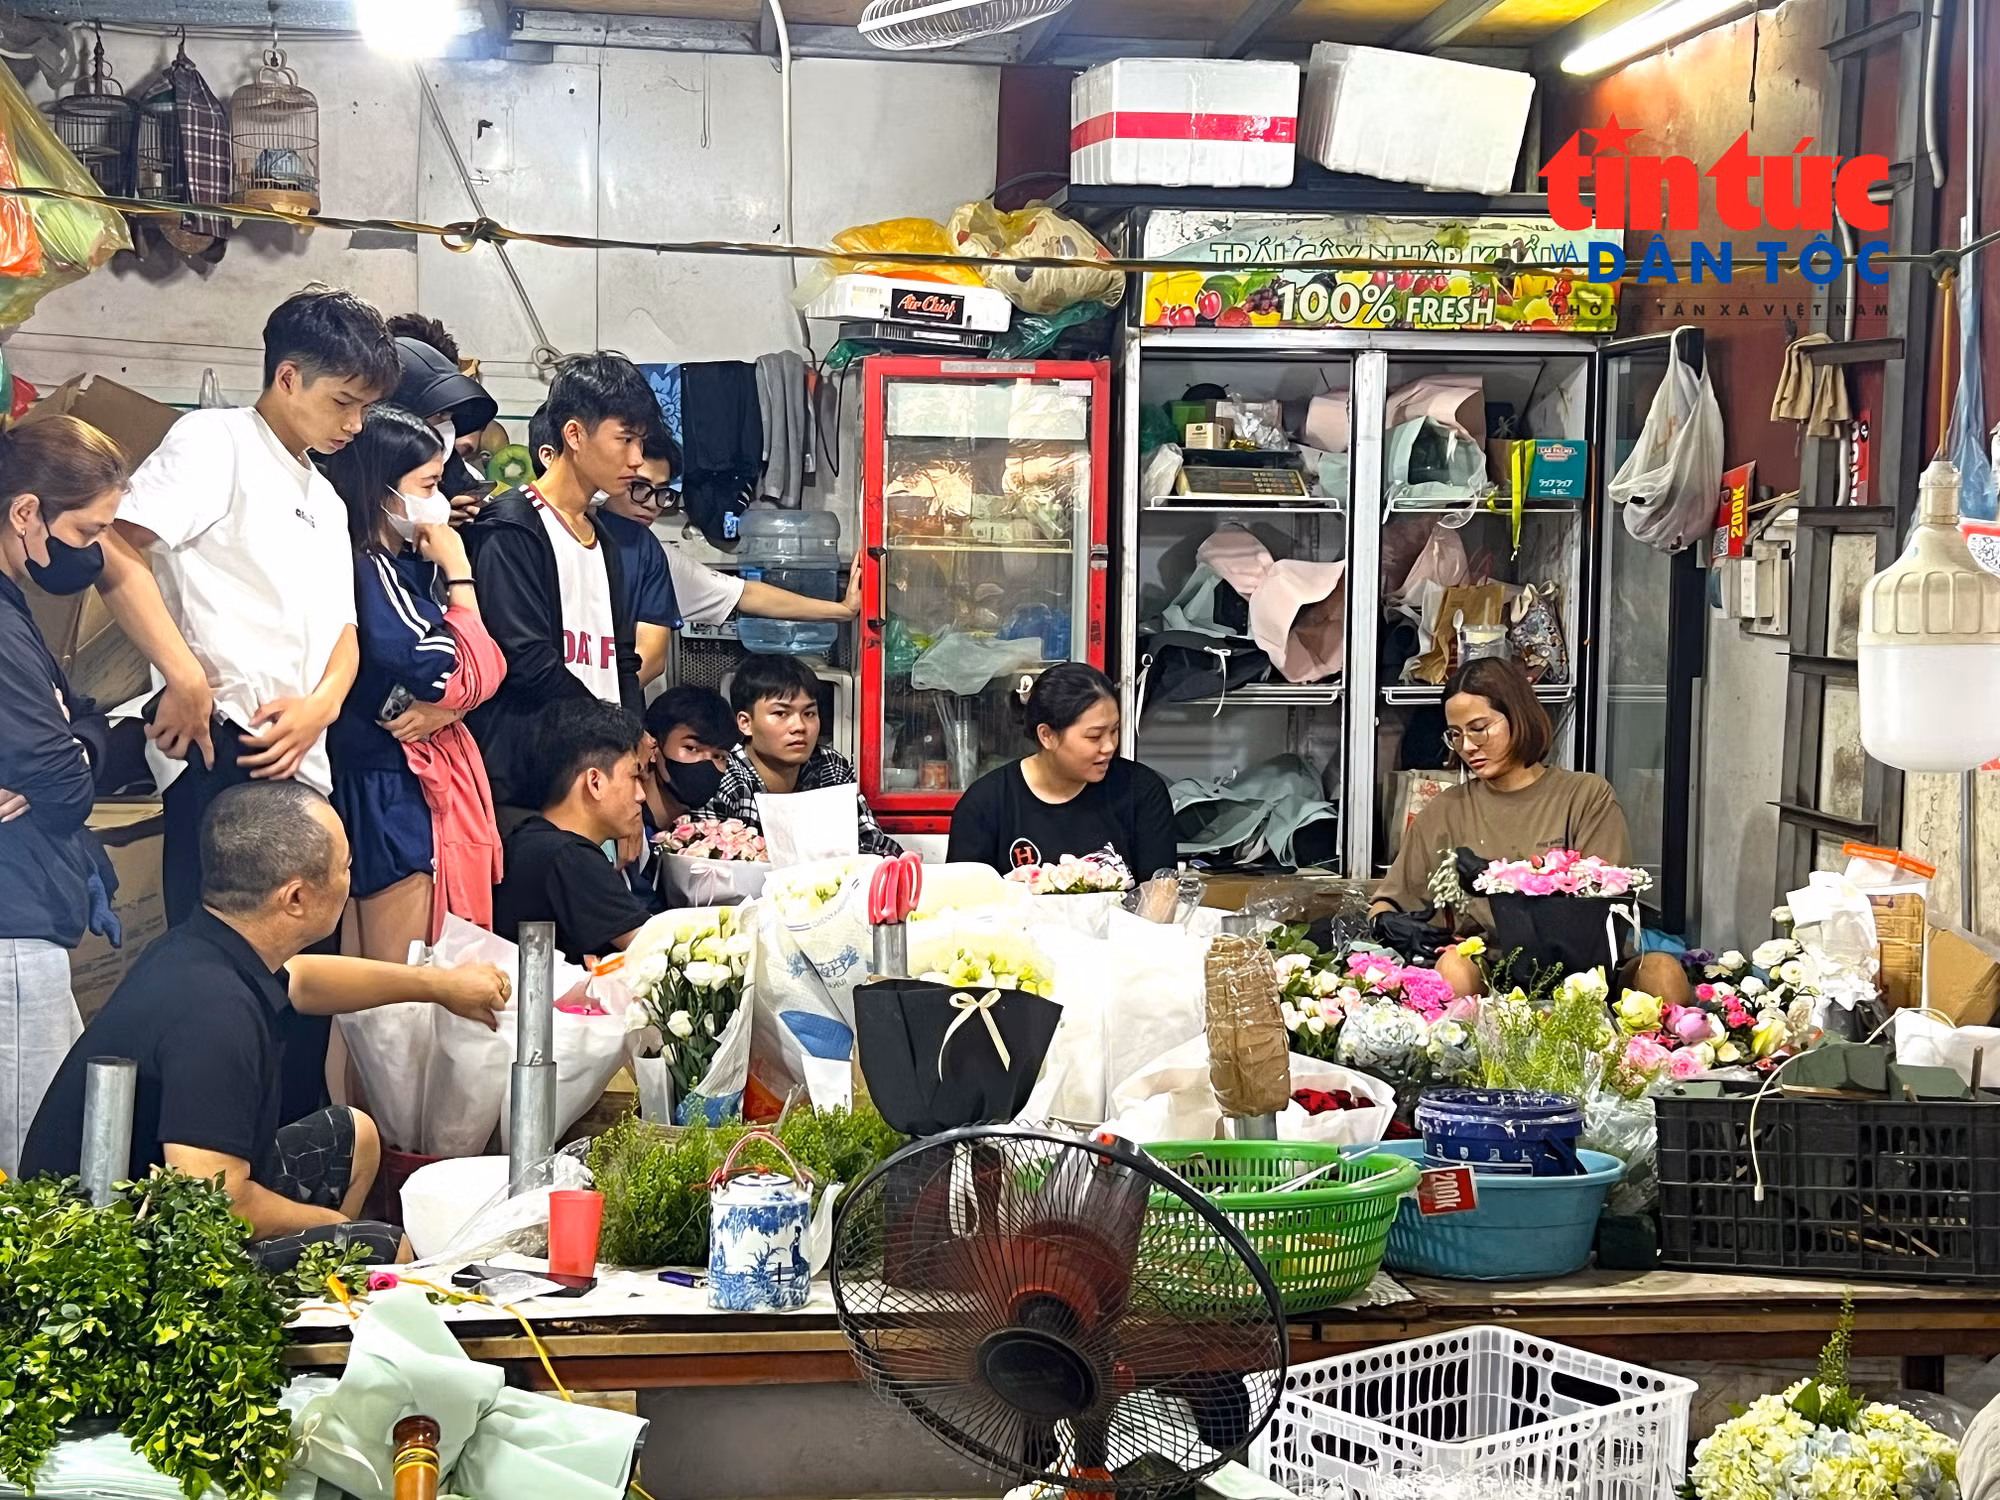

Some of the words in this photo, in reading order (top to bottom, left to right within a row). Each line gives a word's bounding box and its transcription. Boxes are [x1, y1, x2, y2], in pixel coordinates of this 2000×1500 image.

[1277, 282, 1397, 323] 100%
[1405, 296, 1495, 324] FRESH
[1730, 484, 1745, 539] 200K
[1013, 846, 1035, 866] H
[1429, 1172, 1461, 1210] 200K
